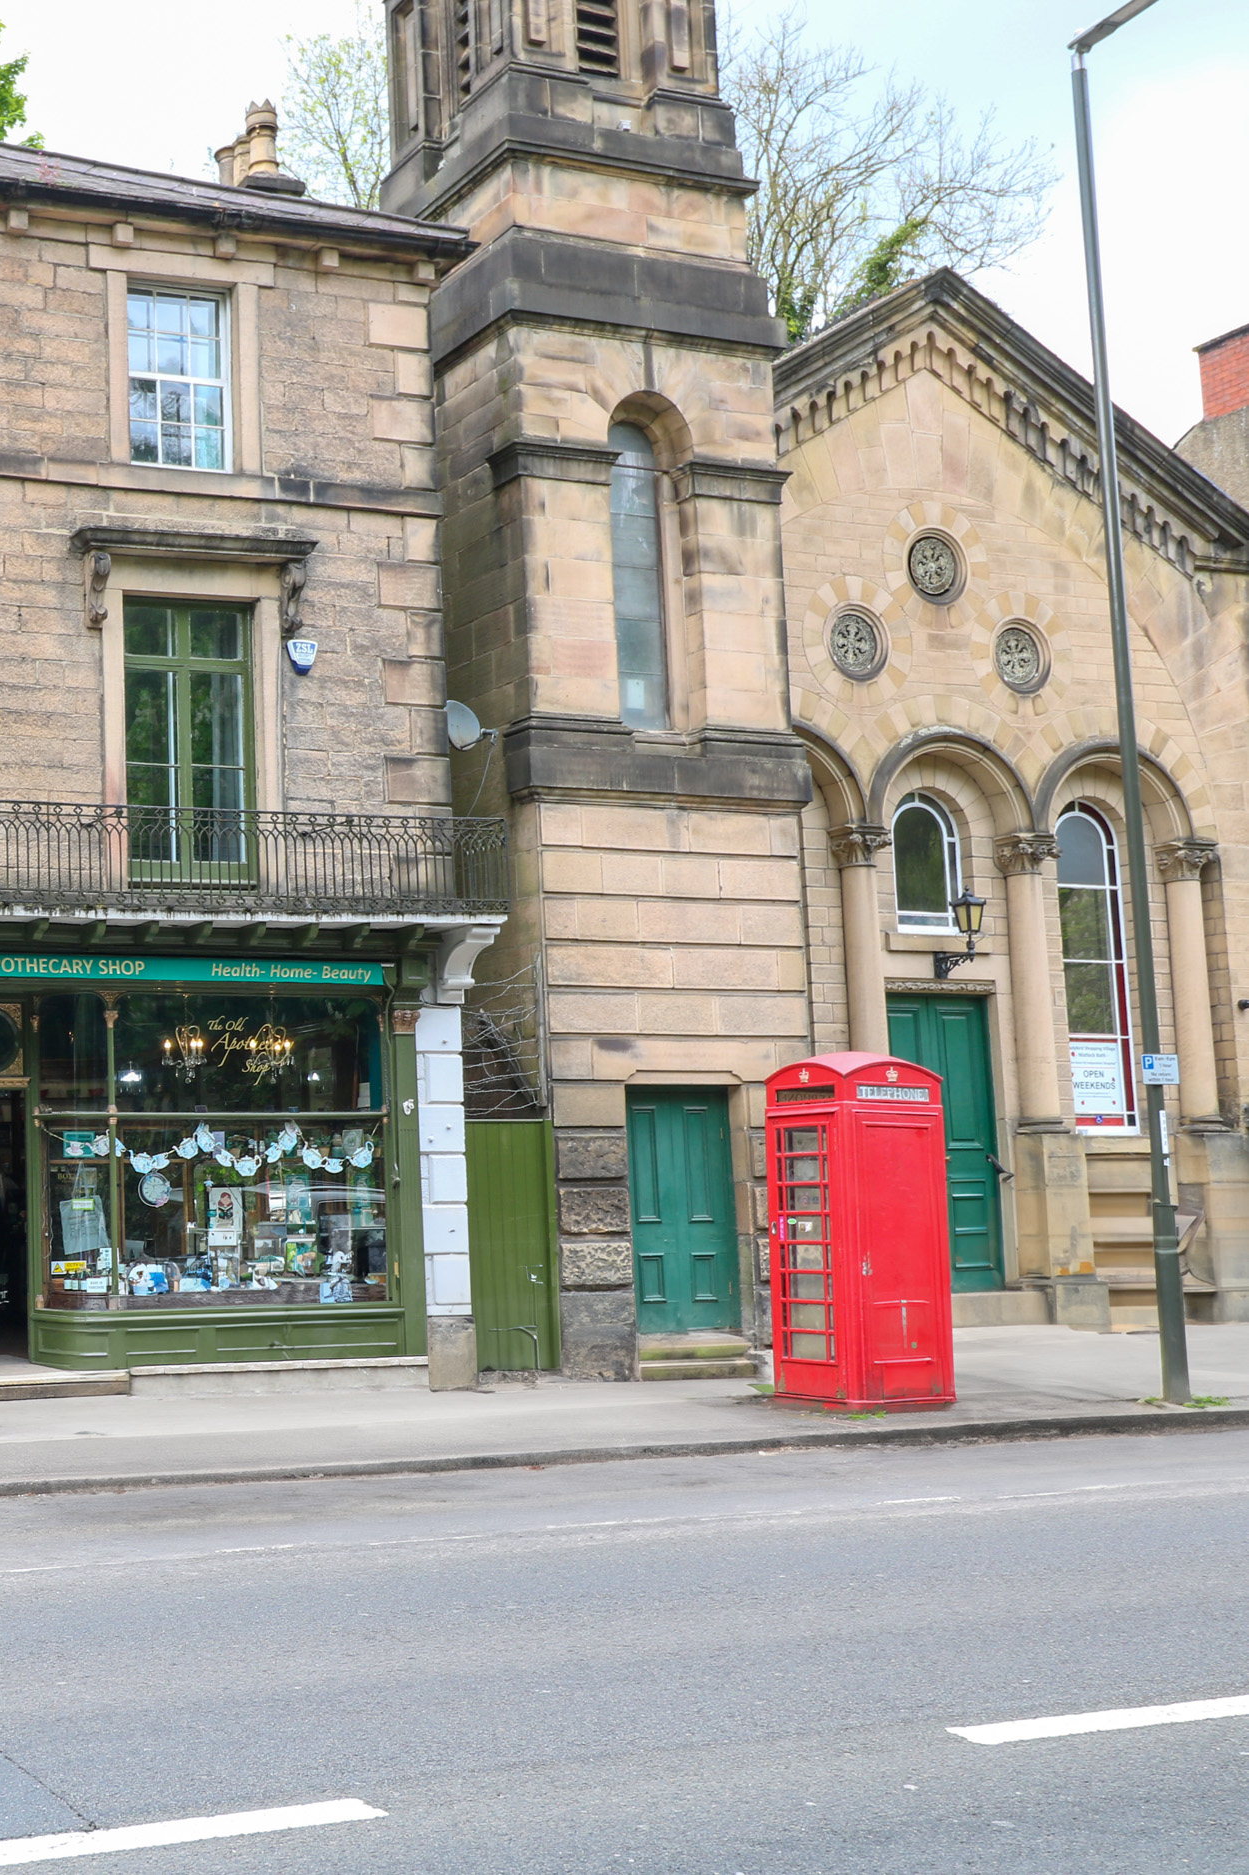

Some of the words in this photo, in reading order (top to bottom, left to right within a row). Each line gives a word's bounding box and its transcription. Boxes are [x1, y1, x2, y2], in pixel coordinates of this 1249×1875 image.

[295, 643, 314, 654] ZSL
[98, 960, 145, 976] SHOP
[211, 963, 266, 977] Health-
[321, 966, 371, 983] Beauty
[207, 1015, 225, 1031] The
[225, 1016, 249, 1032] Old
[241, 1052, 272, 1086] Shop
[1083, 1070, 1105, 1078] OPEN
[1073, 1081, 1116, 1090] WEEKENDS
[859, 1086, 925, 1101] TELEPHONE
